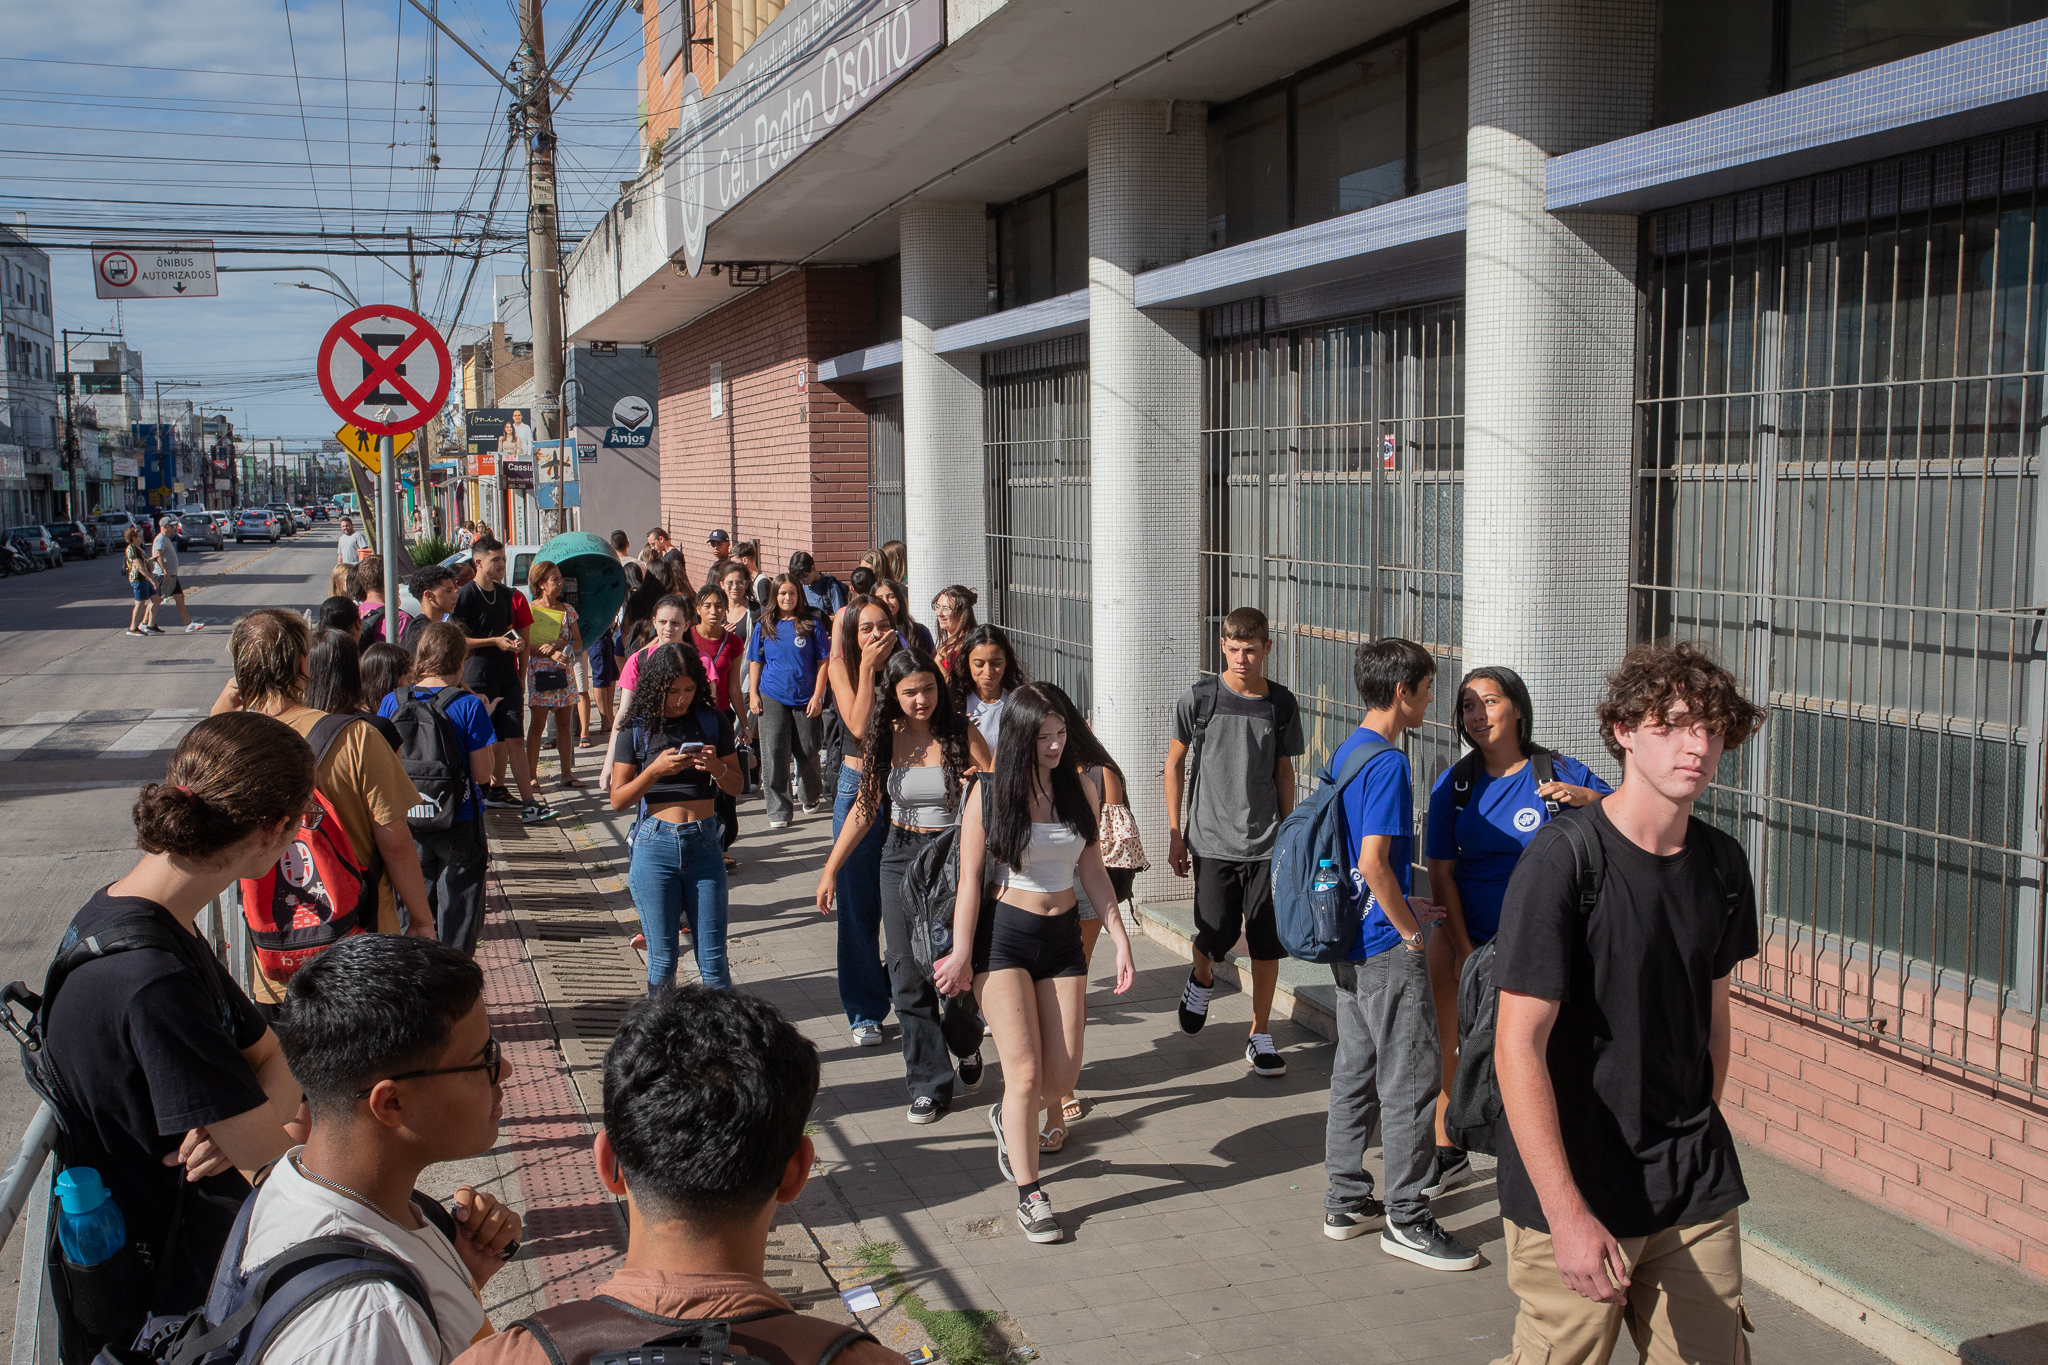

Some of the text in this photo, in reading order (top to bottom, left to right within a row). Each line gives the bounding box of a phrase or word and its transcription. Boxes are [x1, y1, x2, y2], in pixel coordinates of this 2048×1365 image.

[748, 22, 791, 105] Estadual
[793, 12, 808, 58] de
[719, 132, 750, 207] Cel.
[755, 88, 814, 182] Pedro
[821, 0, 911, 124] Osório
[156, 256, 194, 268] ÔNIBUS
[142, 270, 212, 281] AUTORIZADOS
[467, 409, 505, 426] Tonin
[610, 432, 646, 446] Anjos
